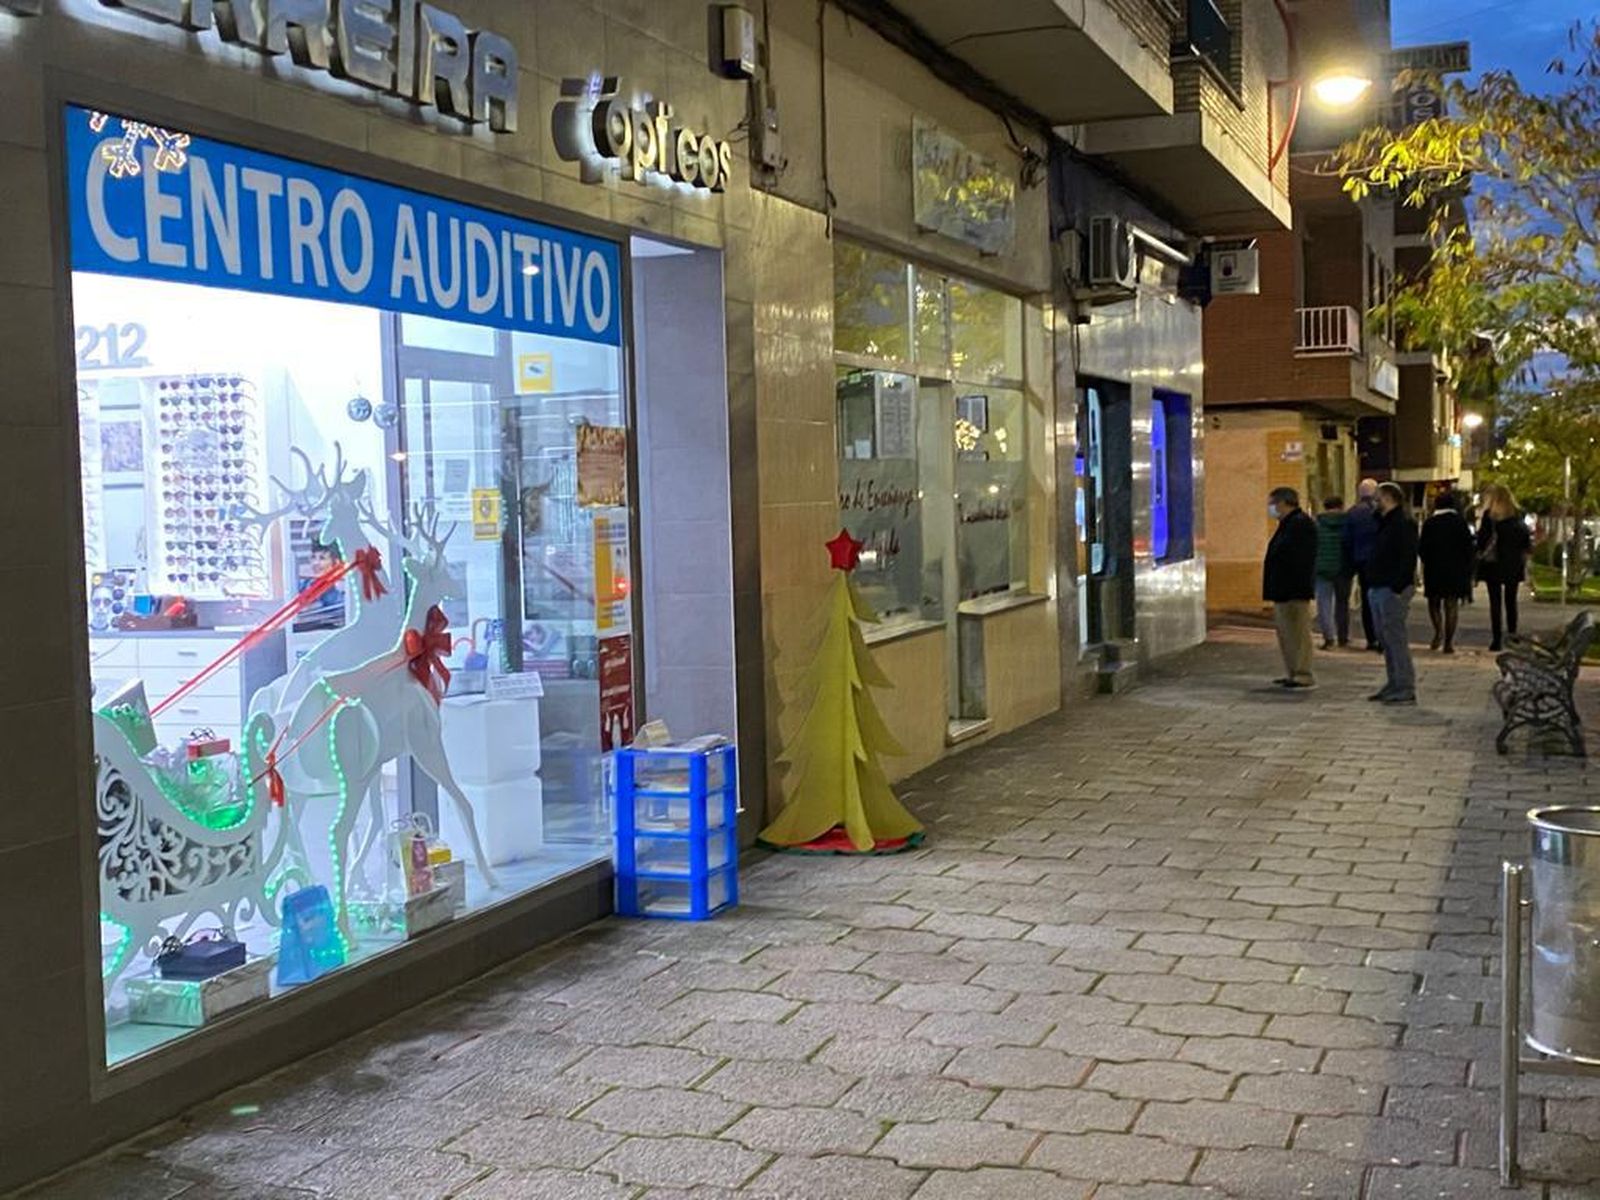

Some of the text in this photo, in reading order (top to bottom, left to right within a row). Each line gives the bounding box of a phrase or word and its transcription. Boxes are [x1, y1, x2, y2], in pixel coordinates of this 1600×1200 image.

[86, 138, 612, 334] CENTRO AUDITIVO
[77, 321, 149, 369] 212
